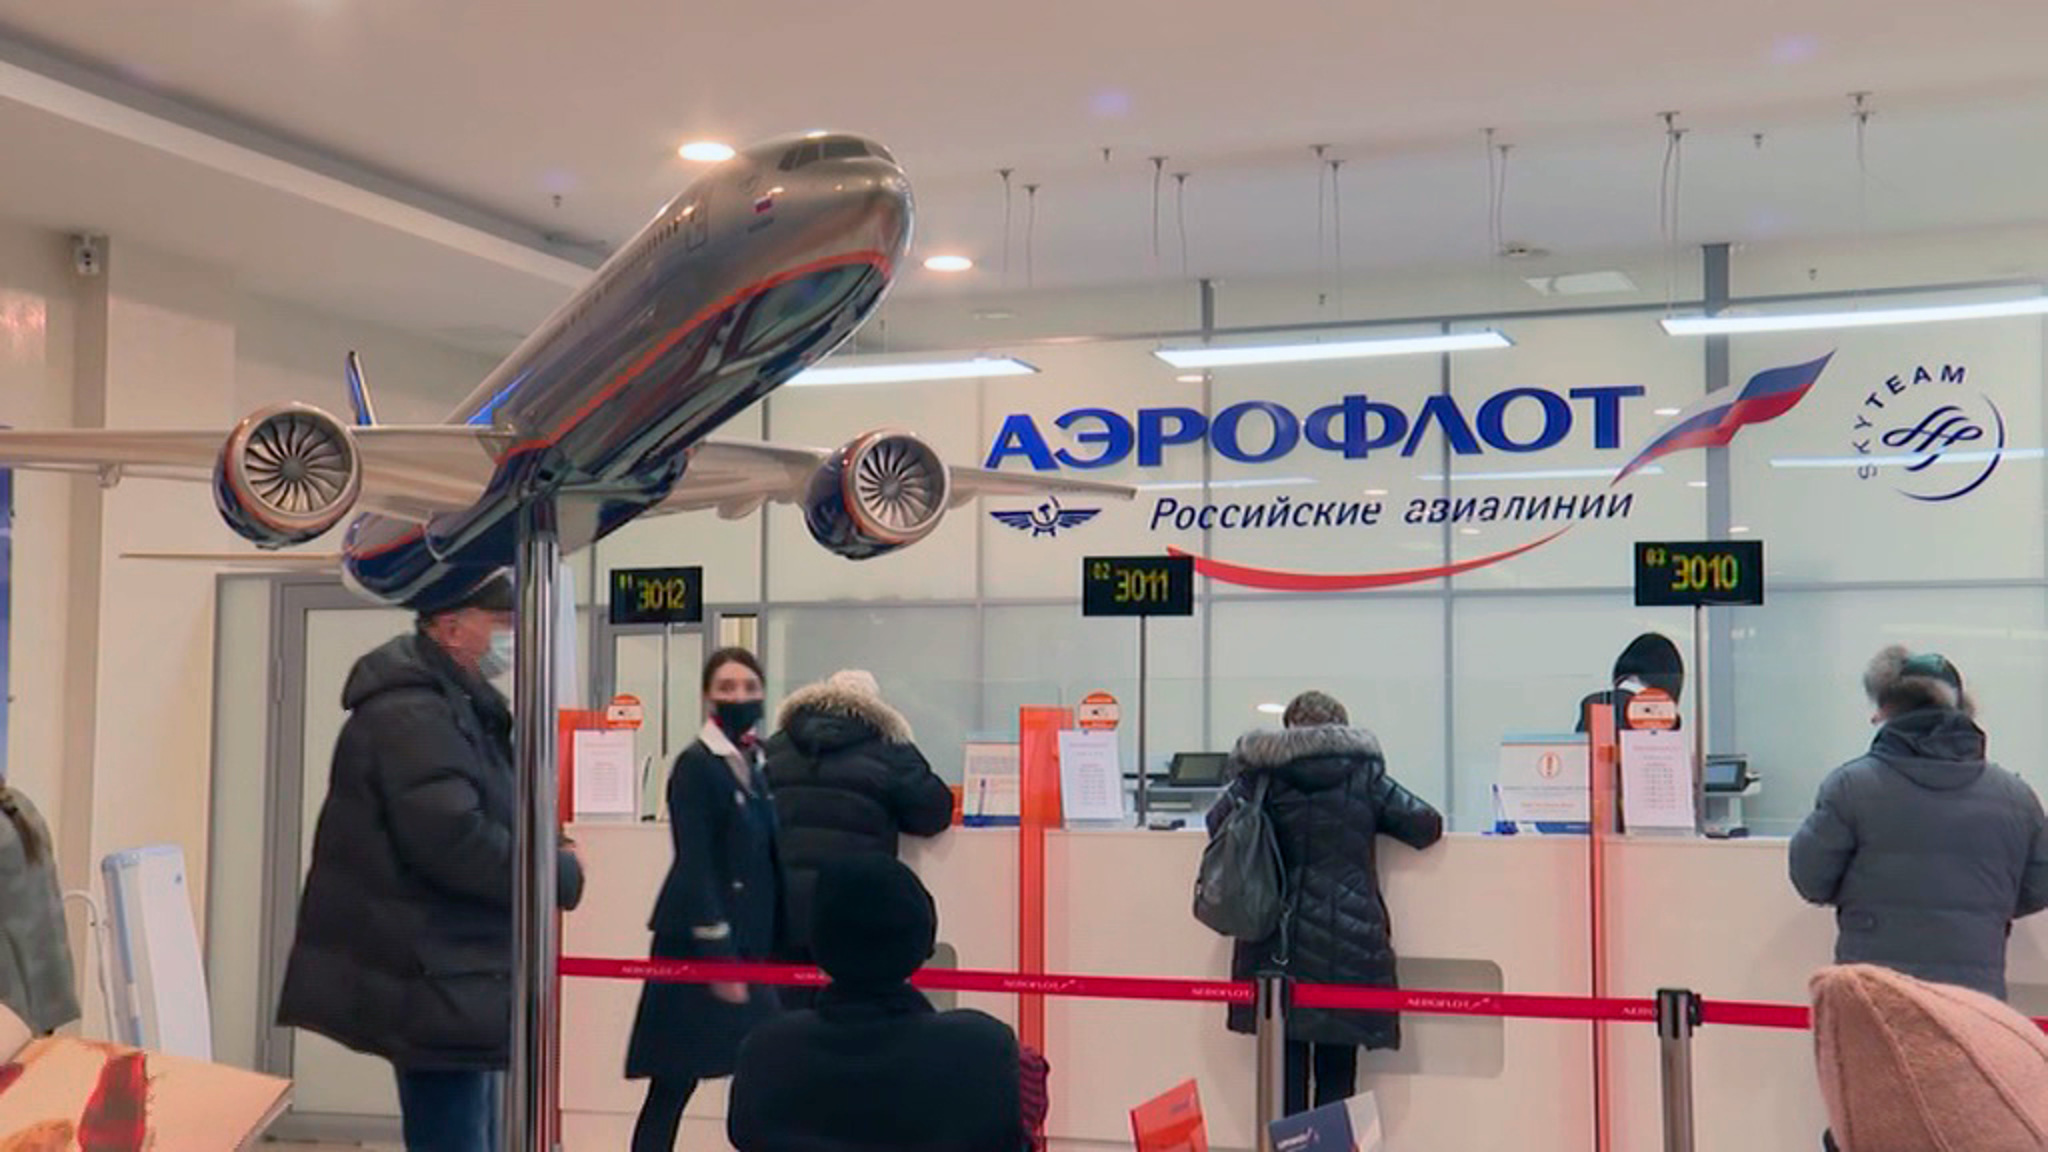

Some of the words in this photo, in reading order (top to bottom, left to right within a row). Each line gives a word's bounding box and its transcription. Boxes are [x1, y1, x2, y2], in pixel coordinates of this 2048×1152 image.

[985, 385, 1645, 471] АЭРОФЛОТ
[1853, 364, 1966, 480] SKYTEAM
[1150, 497, 1382, 530] Российские
[1404, 494, 1634, 524] авиалинии
[1116, 569, 1168, 601] 3011
[1671, 554, 1738, 589] 3010
[637, 578, 686, 609] 3012
